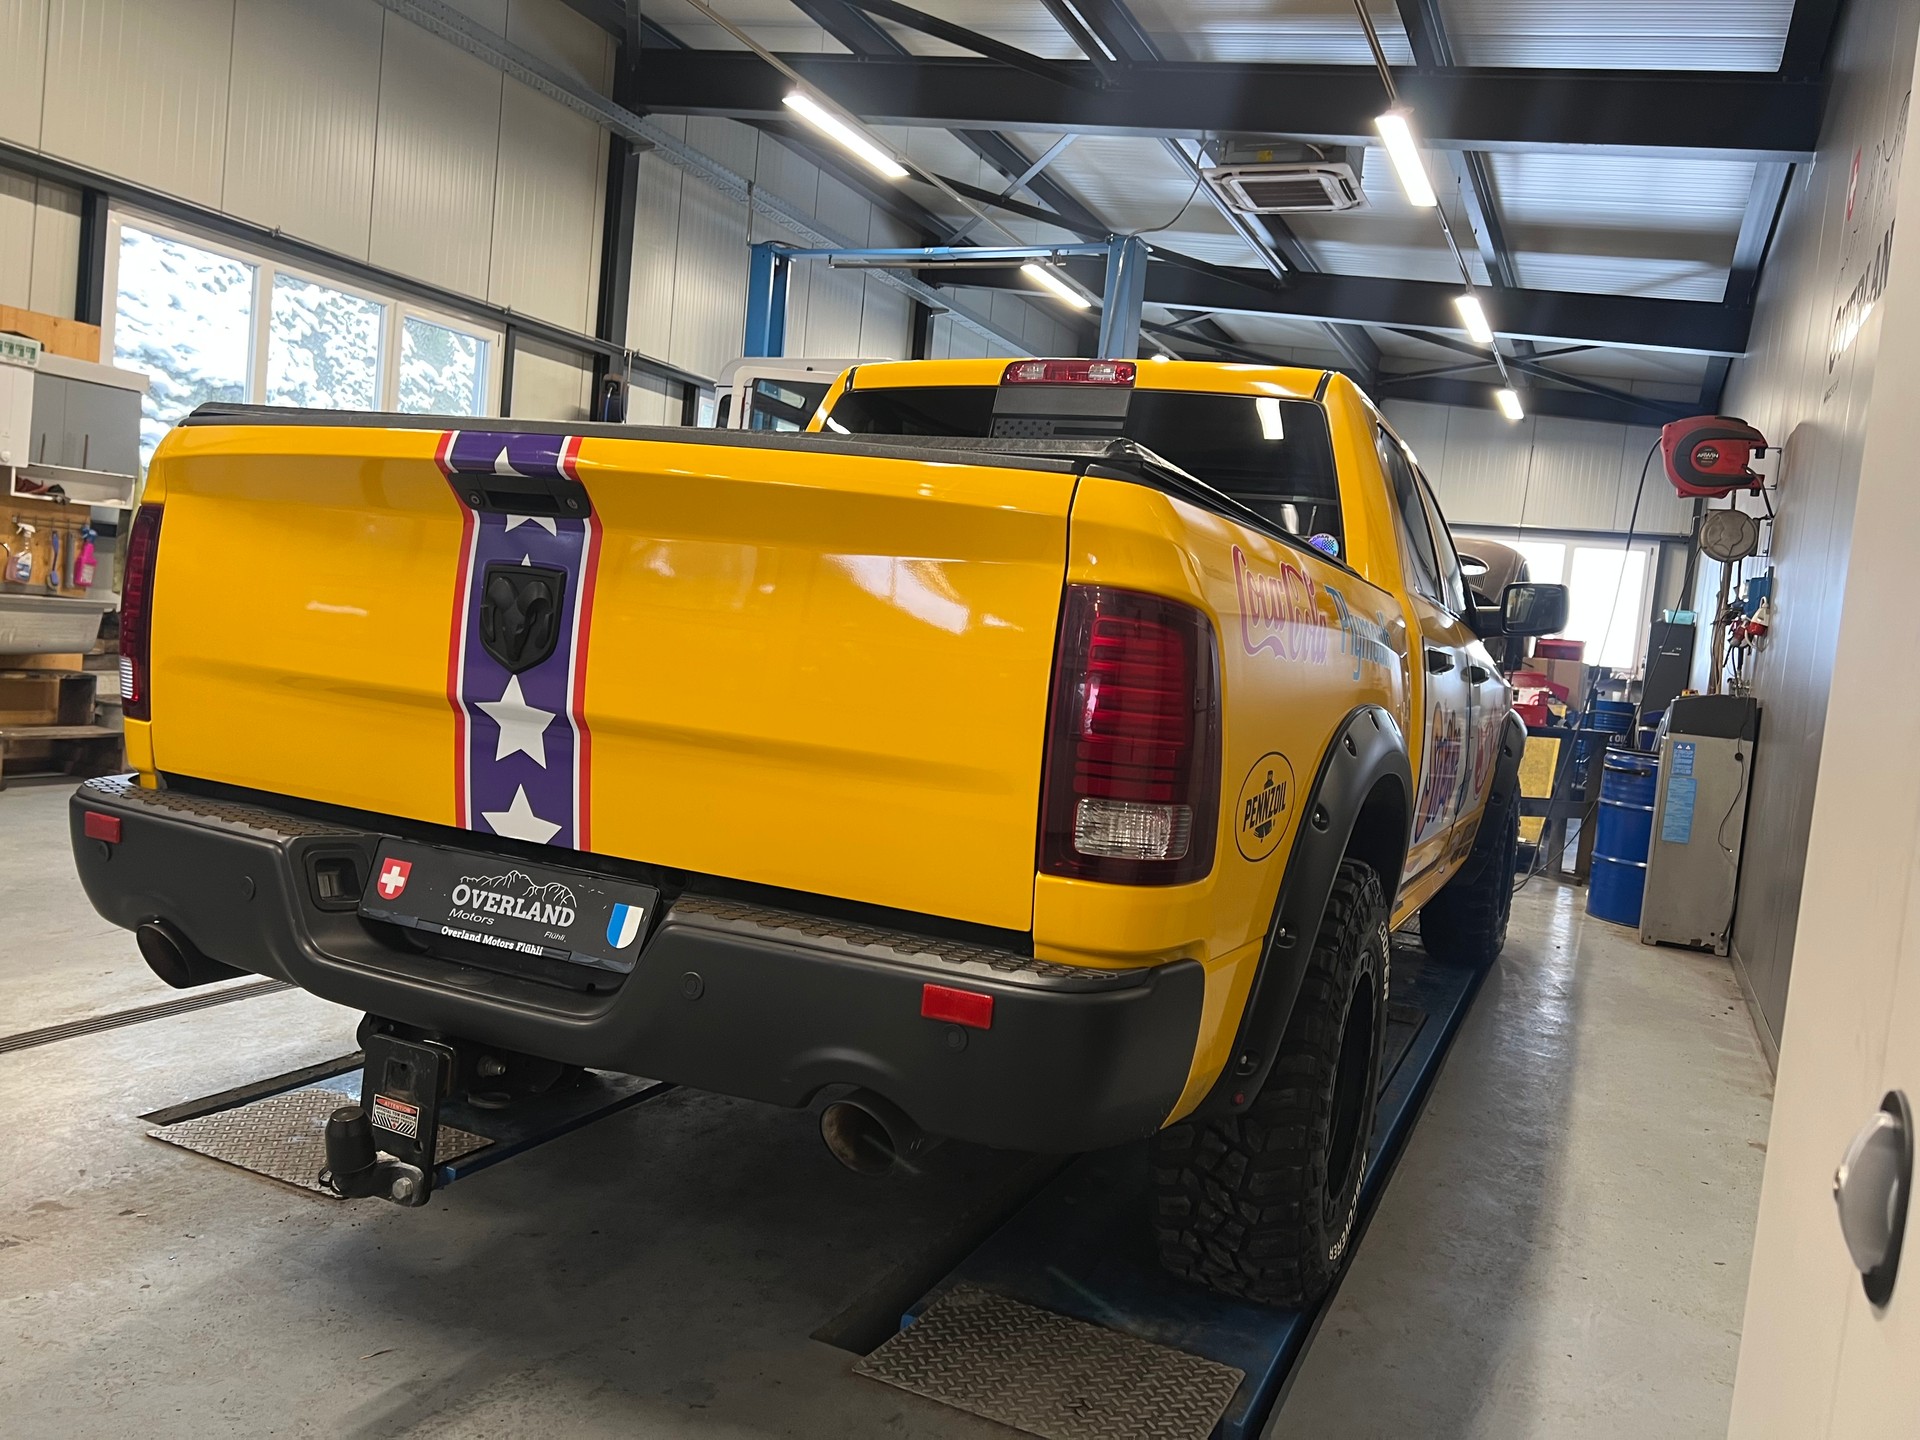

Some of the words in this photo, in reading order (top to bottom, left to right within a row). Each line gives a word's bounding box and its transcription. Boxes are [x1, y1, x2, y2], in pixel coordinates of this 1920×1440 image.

[1242, 780, 1287, 832] PENNZOIL
[449, 908, 495, 926] Motors
[452, 884, 575, 928] OVERLAND
[441, 926, 483, 945] Overland
[482, 935, 515, 951] Motors
[517, 942, 544, 956] Flühli
[1377, 921, 1390, 1002] COOPER
[1329, 1151, 1367, 1260] DISCOVERER
